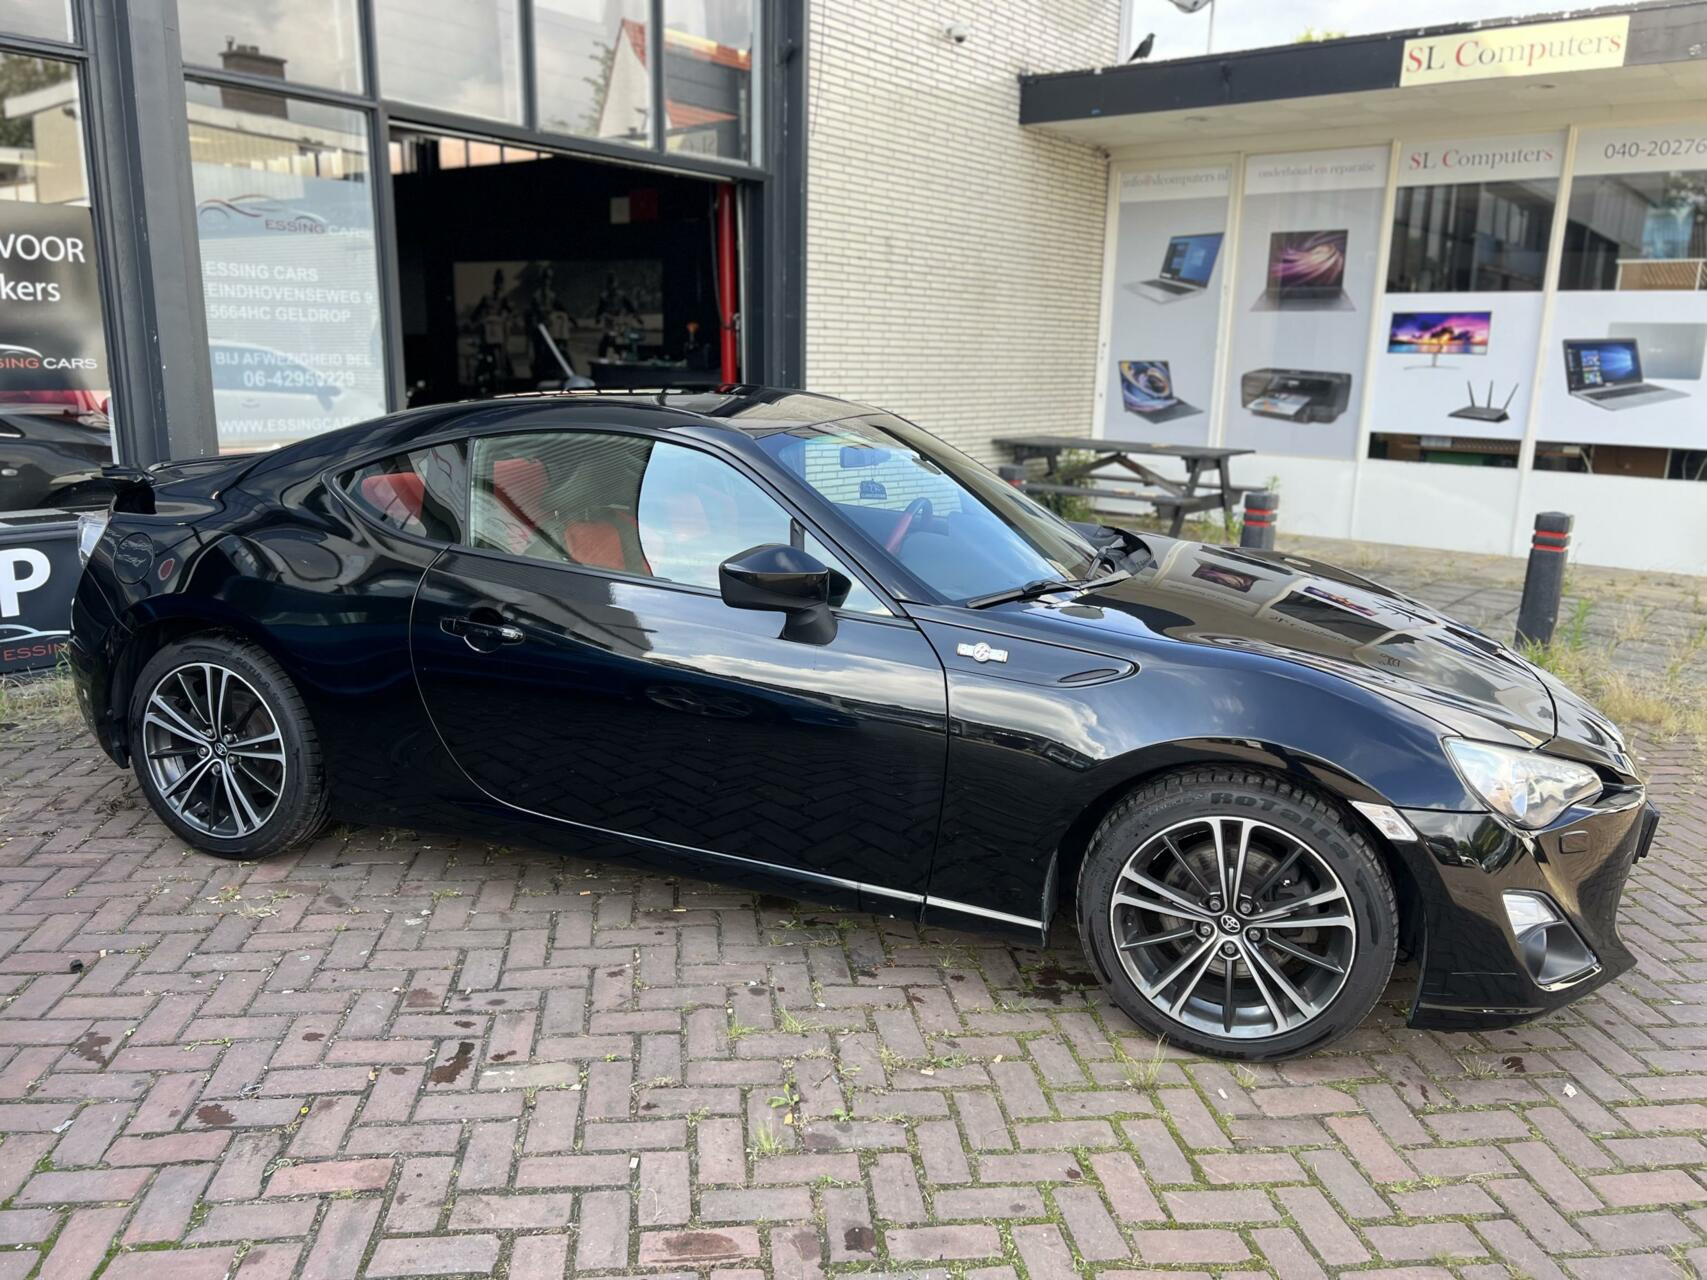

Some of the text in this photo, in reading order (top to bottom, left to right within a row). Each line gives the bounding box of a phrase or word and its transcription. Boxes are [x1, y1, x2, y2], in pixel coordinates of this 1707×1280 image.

[1406, 33, 1622, 73] SL Computers
[1409, 147, 1554, 171] SL Computers
[1604, 137, 1707, 160] 040-20276
[265, 219, 325, 234] ESSING
[0, 232, 86, 264] VOOR
[206, 261, 320, 283] ESSING CARS
[0, 273, 62, 302] kers
[207, 283, 361, 305] EINDHOVENSEWEG
[209, 304, 352, 323] 5664HC GELDROP
[42, 357, 98, 370] CARS
[215, 352, 239, 366] BIJ
[242, 352, 344, 367] AFWEZIGHEID
[4, 642, 71, 662] ESSIN
